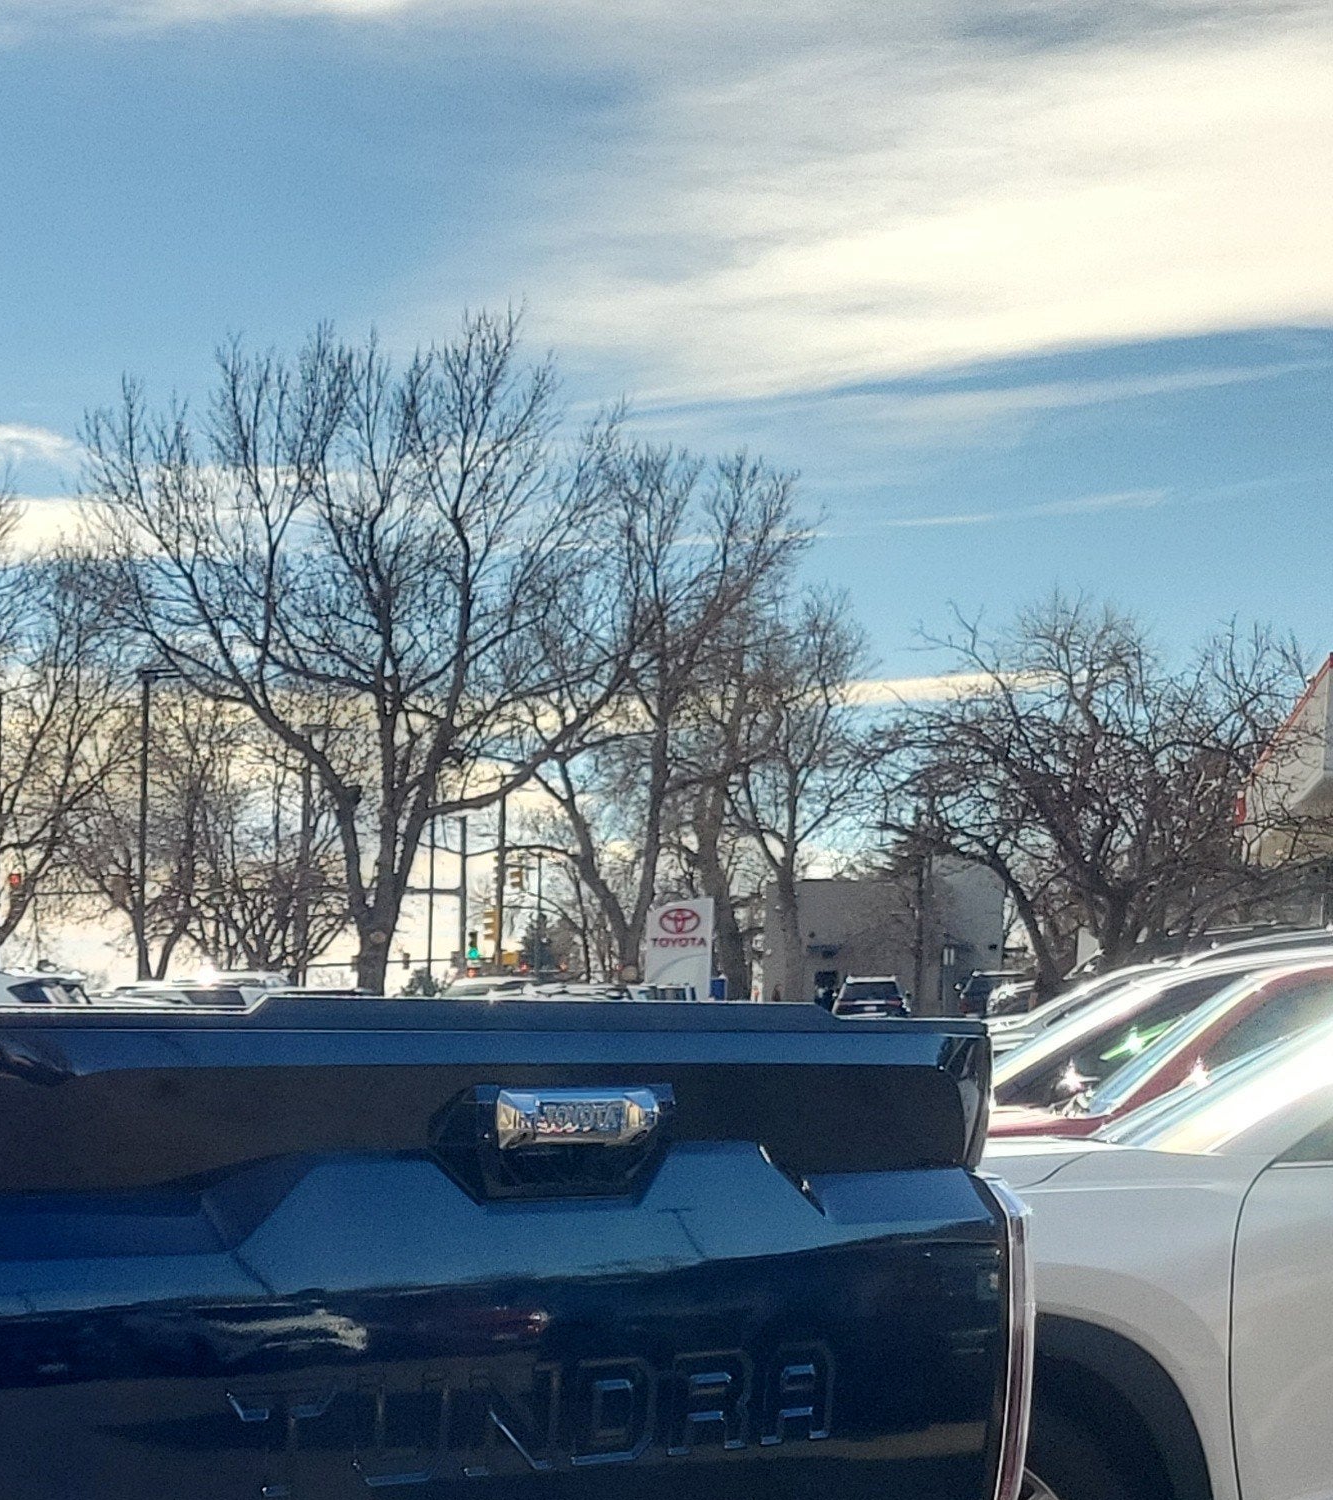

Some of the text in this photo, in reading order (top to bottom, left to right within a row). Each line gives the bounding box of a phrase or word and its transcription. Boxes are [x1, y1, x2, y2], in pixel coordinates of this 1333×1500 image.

[651, 937, 707, 948] TOYOTA
[541, 1103, 624, 1133] TOYOTA
[225, 1341, 832, 1500] TUNDRA
